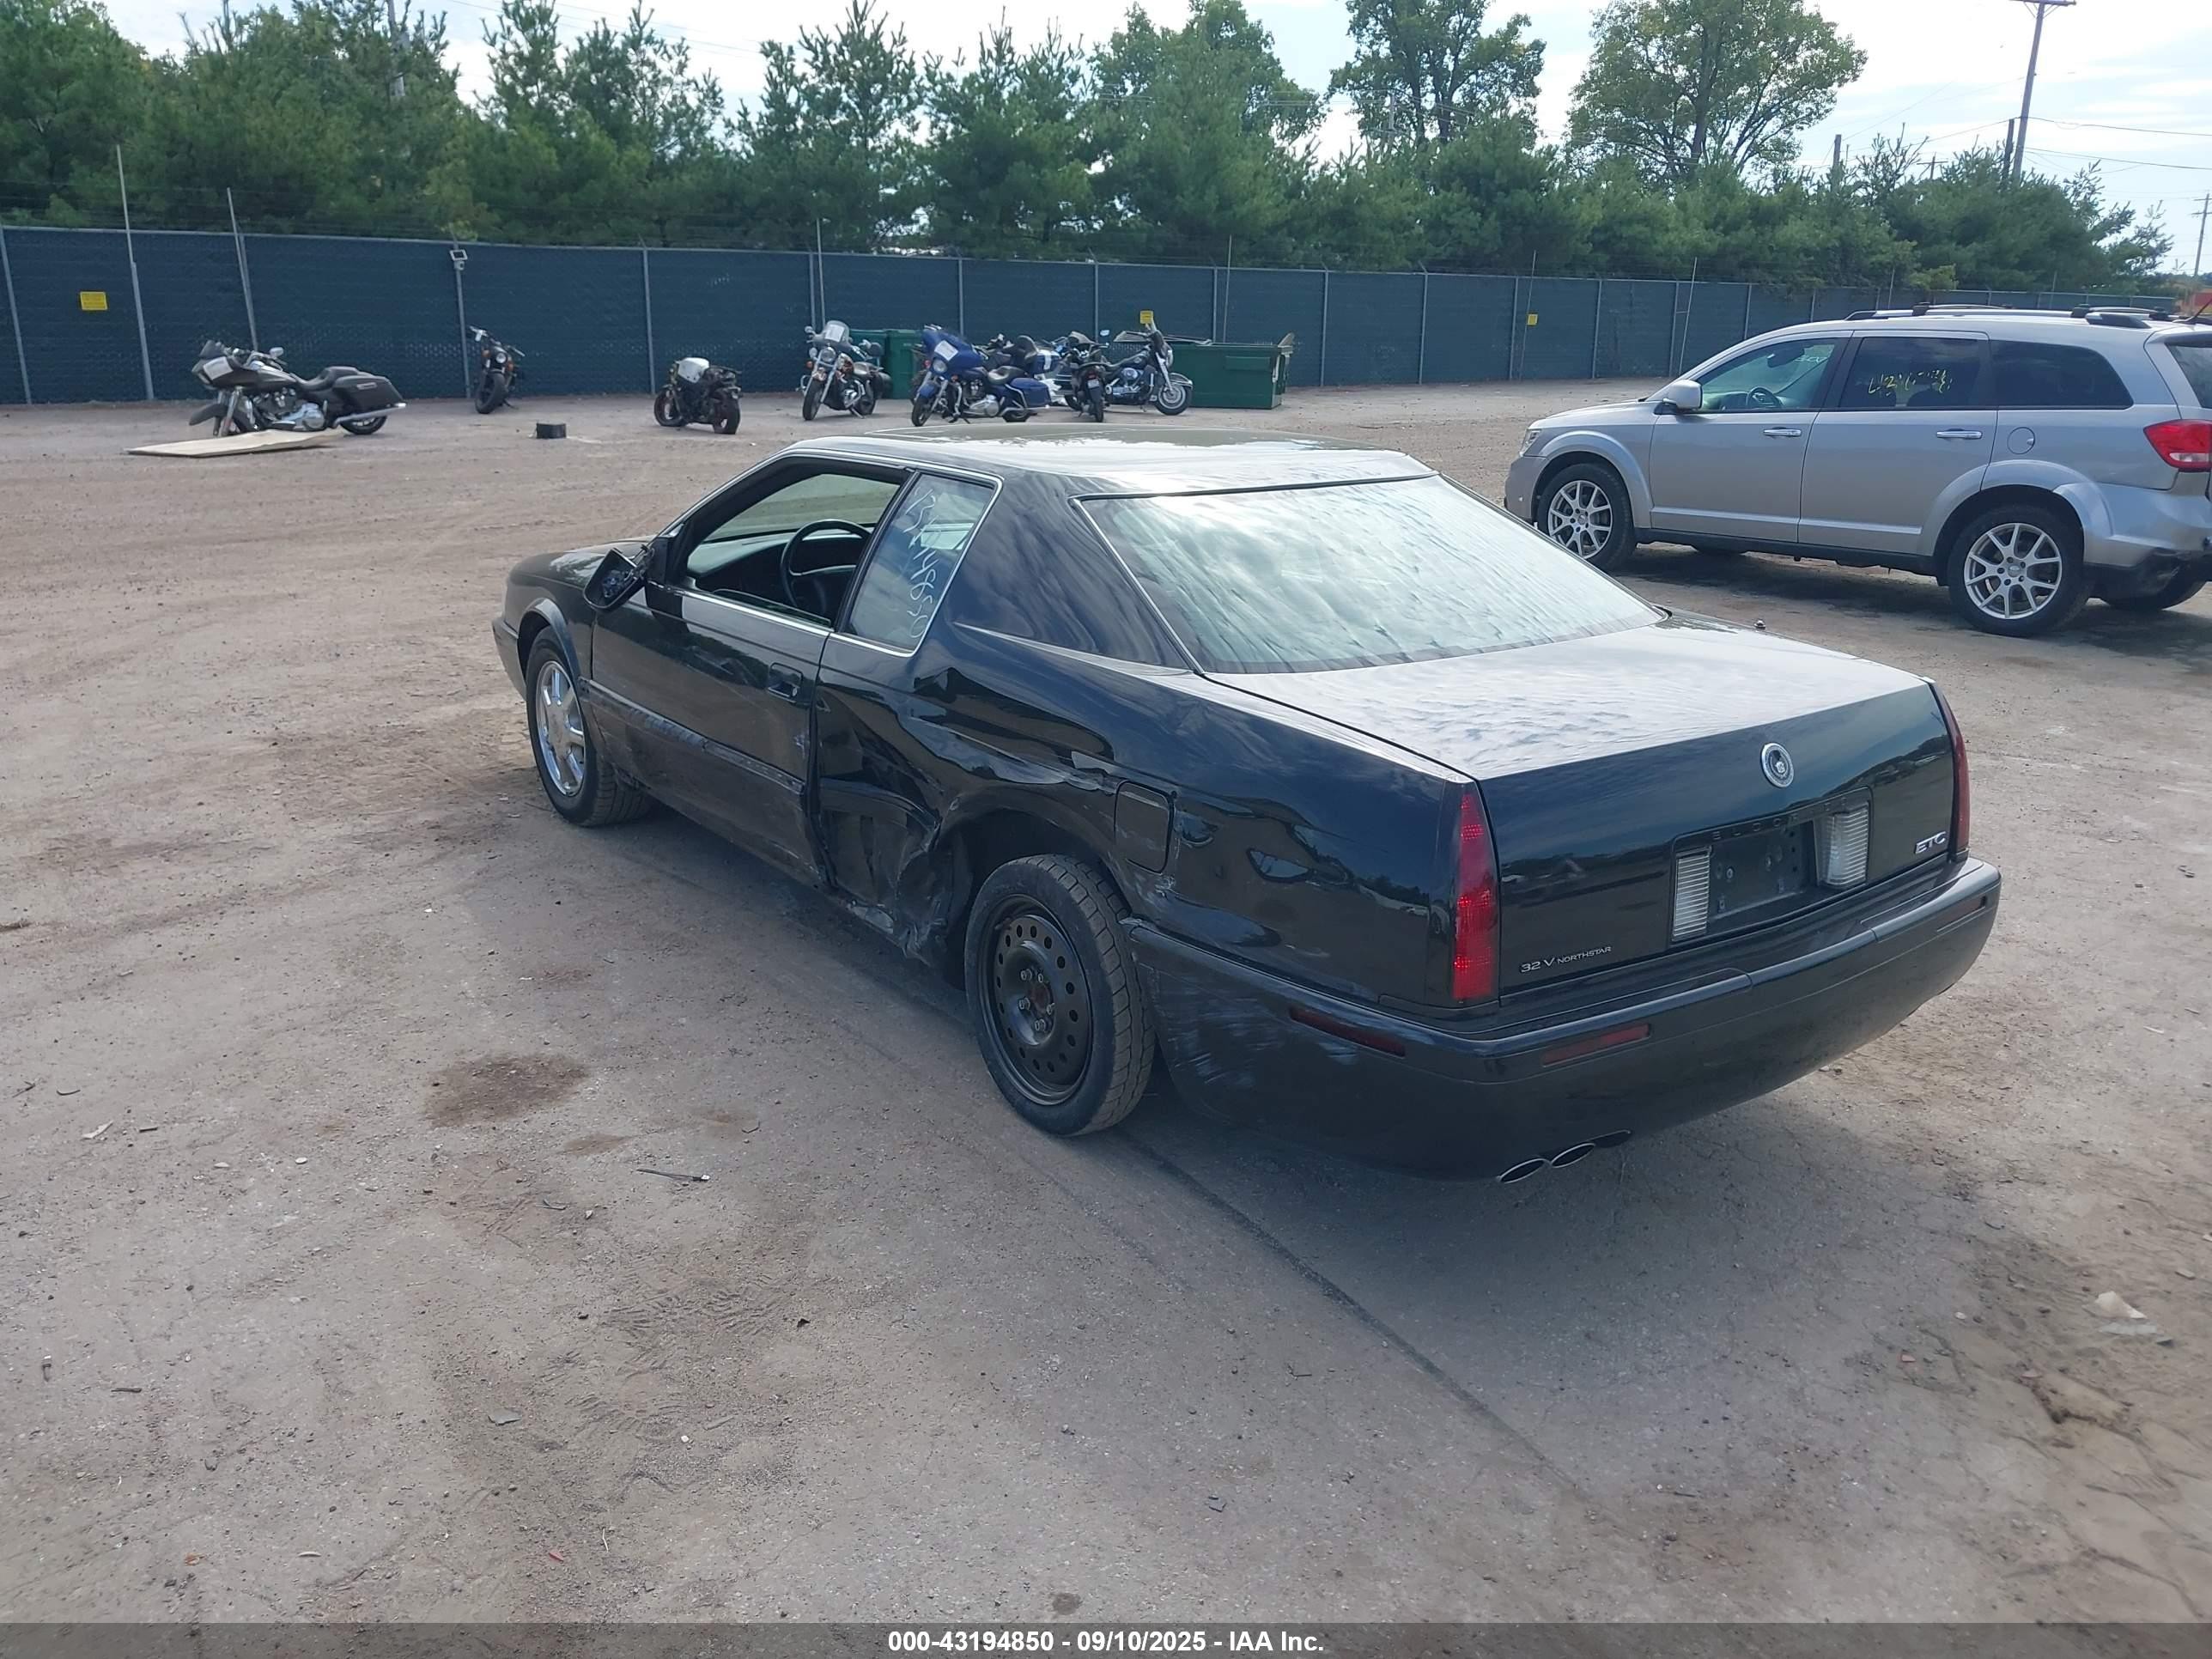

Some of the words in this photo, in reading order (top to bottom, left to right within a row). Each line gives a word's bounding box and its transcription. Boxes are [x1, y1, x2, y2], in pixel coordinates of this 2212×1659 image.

[1914, 830, 1947, 854] ETC
[1521, 961, 1541, 972] 32
[1543, 957, 1555, 967] V
[1557, 946, 1612, 964] NORTHSTAR
